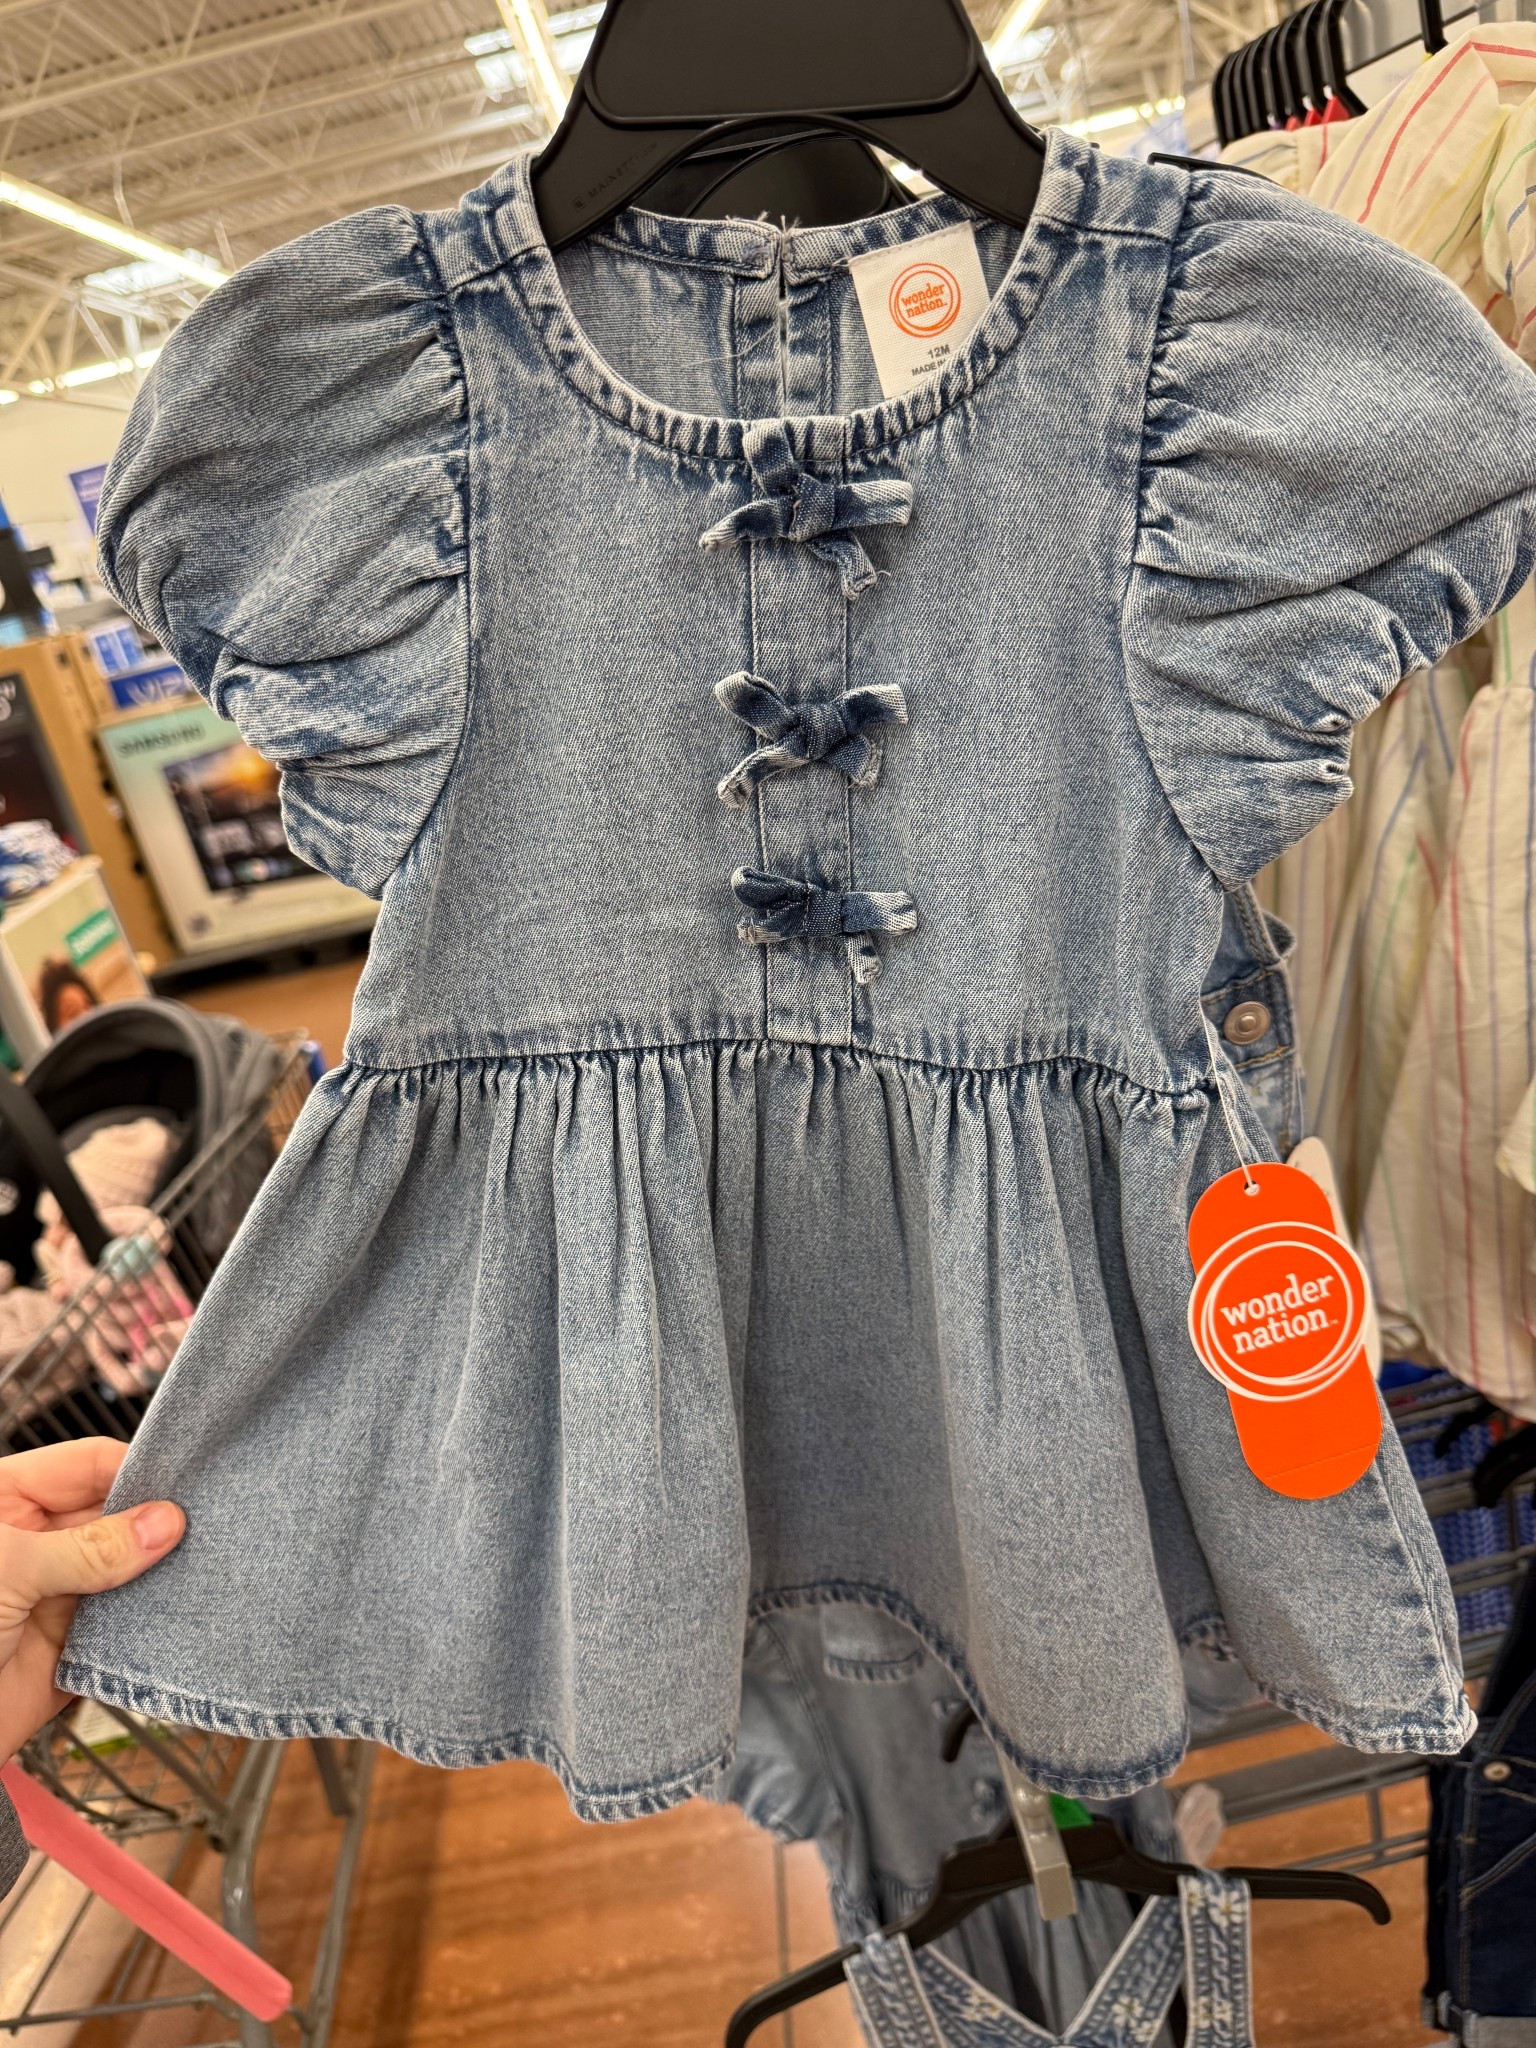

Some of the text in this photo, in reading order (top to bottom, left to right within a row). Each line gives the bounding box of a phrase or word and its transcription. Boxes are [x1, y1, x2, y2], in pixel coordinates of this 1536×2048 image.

[901, 283, 945, 307] wonder
[928, 344, 950, 359] 12M
[911, 362, 937, 376] MADE
[1220, 1273, 1334, 1327] wonder
